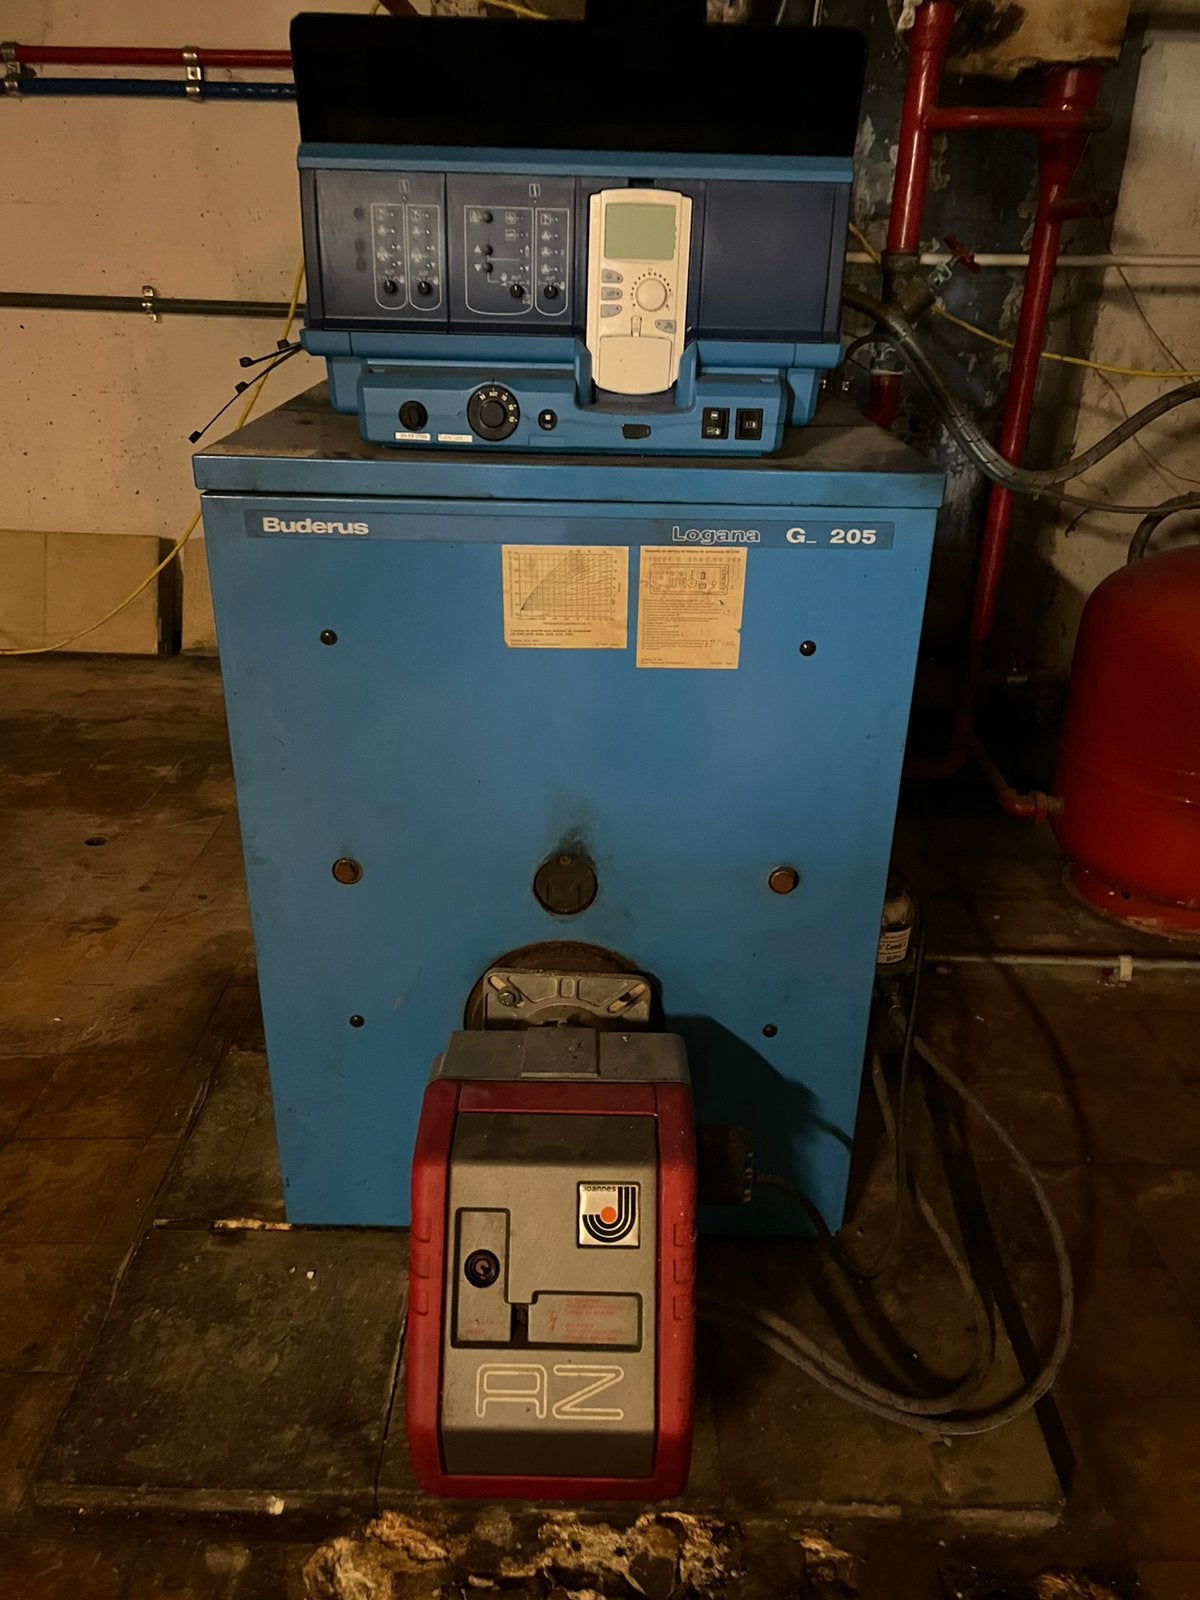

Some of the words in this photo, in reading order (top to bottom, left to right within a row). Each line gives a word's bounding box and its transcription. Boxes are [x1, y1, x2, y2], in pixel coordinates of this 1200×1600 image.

[262, 517, 369, 535] Buderus
[672, 526, 760, 545] Logana
[829, 529, 877, 544] 205
[475, 1363, 625, 1420] AZ
